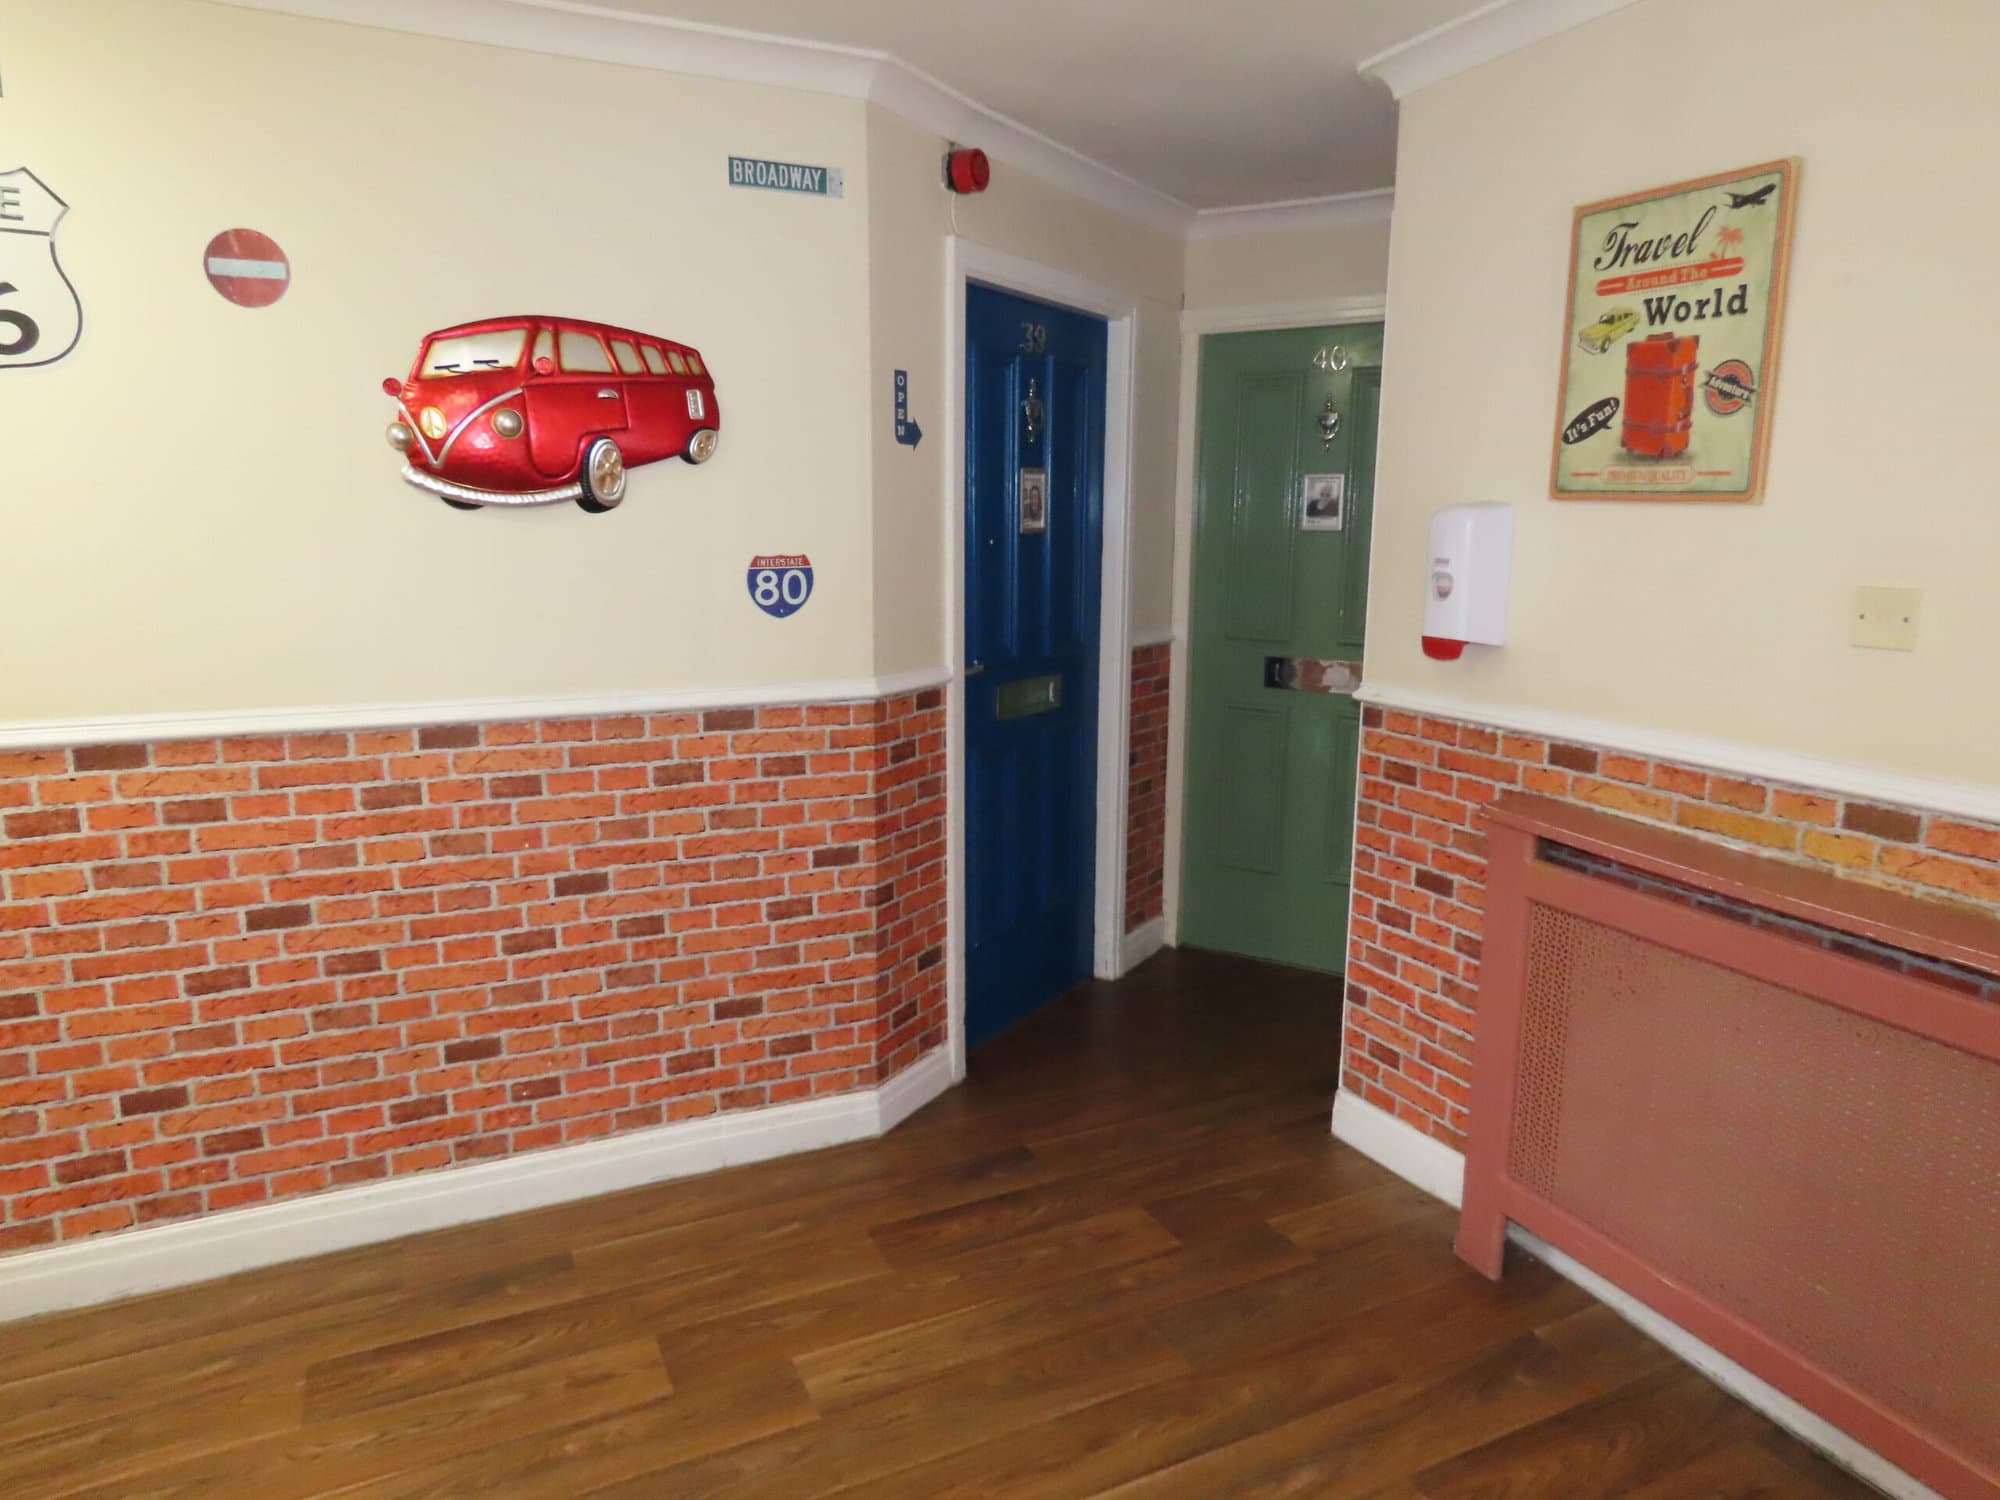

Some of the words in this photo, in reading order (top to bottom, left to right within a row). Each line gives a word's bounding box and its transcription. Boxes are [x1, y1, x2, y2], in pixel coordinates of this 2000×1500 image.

[732, 159, 822, 191] BROADWAY
[1593, 205, 1718, 271] Travel
[1679, 267, 1710, 283] The
[1643, 283, 1749, 326] World
[1020, 321, 1047, 352] 39
[1312, 345, 1347, 372] 40
[897, 375, 905, 437] OPEN
[1566, 423, 1588, 442] It's
[1588, 399, 1617, 428] Fun!
[756, 558, 803, 567] INTERSTATE
[754, 569, 807, 606] 80
